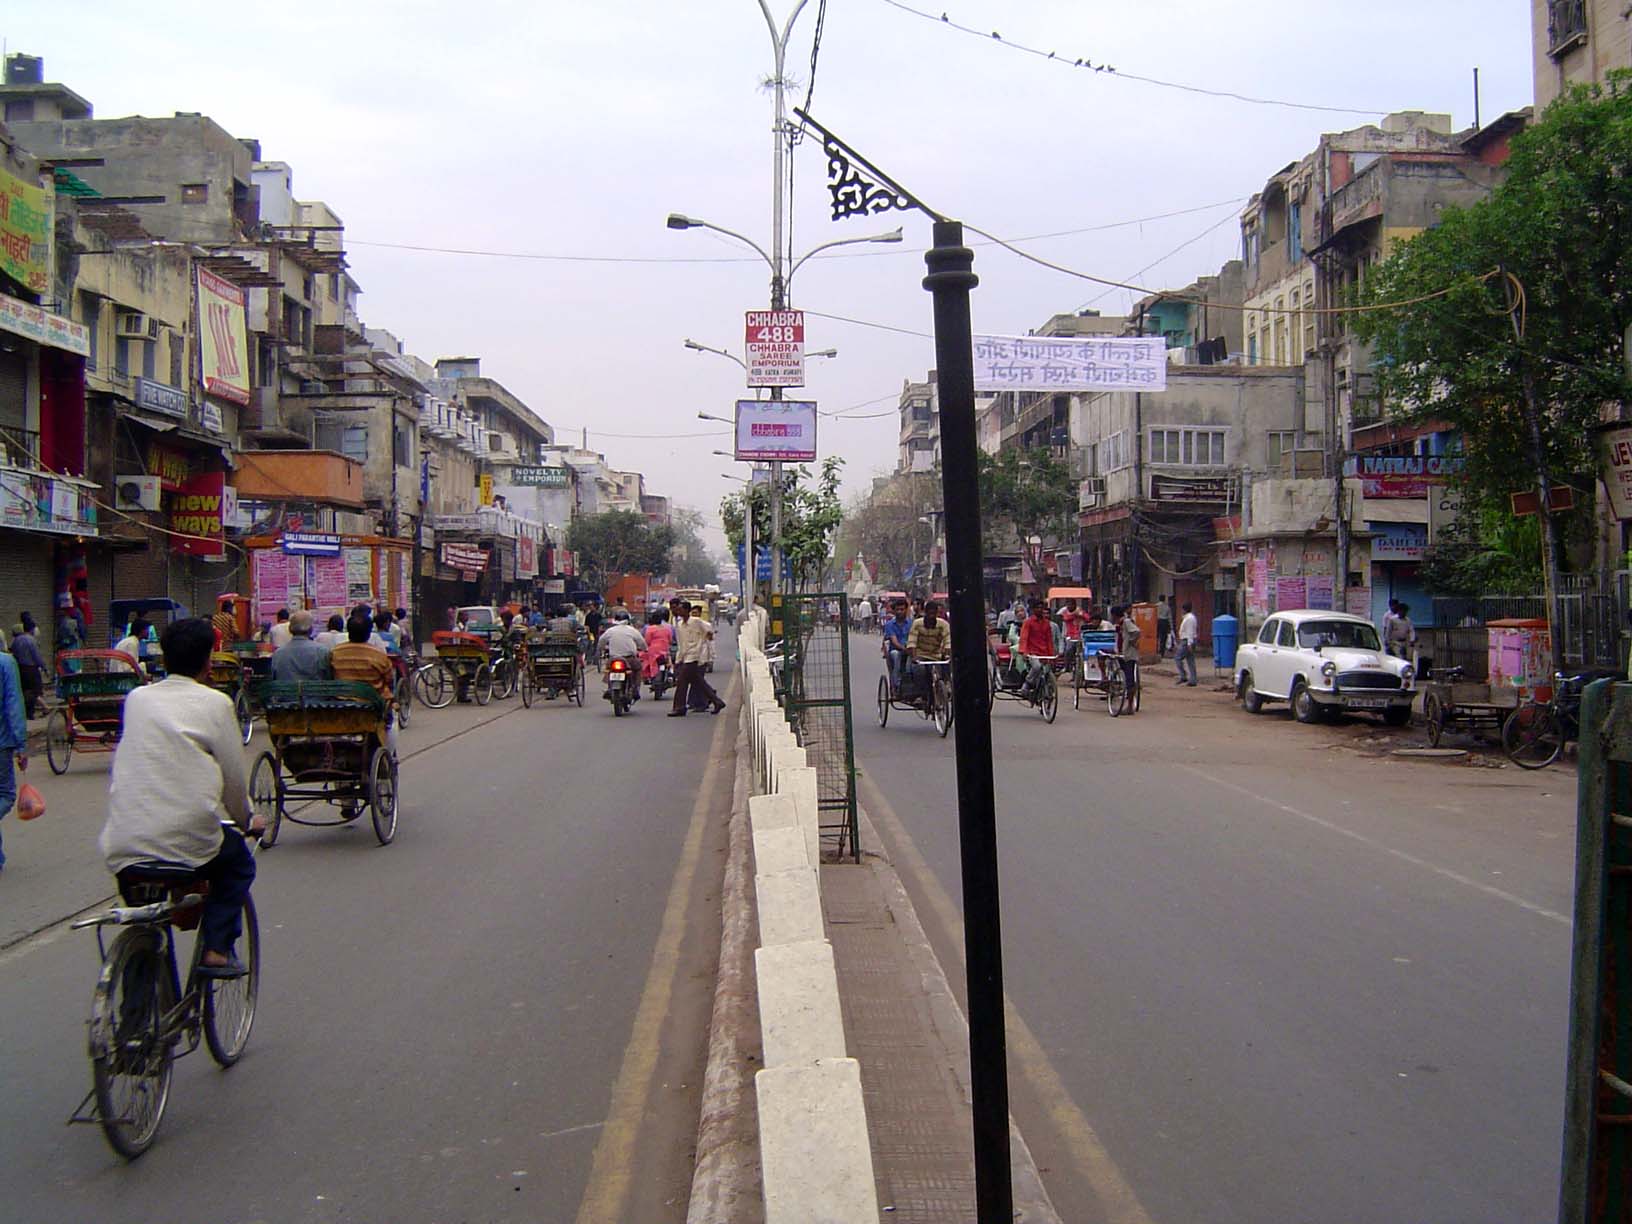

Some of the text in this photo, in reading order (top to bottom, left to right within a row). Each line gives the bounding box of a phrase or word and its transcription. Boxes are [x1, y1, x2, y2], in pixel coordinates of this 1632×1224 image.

[747, 312, 803, 327] CHHABRA
[757, 326, 794, 342] 488
[749, 343, 799, 353] CHHABRA
[759, 352, 792, 360] SAREE
[751, 359, 800, 368] EMPORIUM
[515, 468, 562, 476] NOVELTY
[1363, 457, 1424, 475] NATRAJ
[522, 475, 567, 483] EMPORIUM
[172, 495, 221, 512] new
[173, 515, 221, 537] ways
